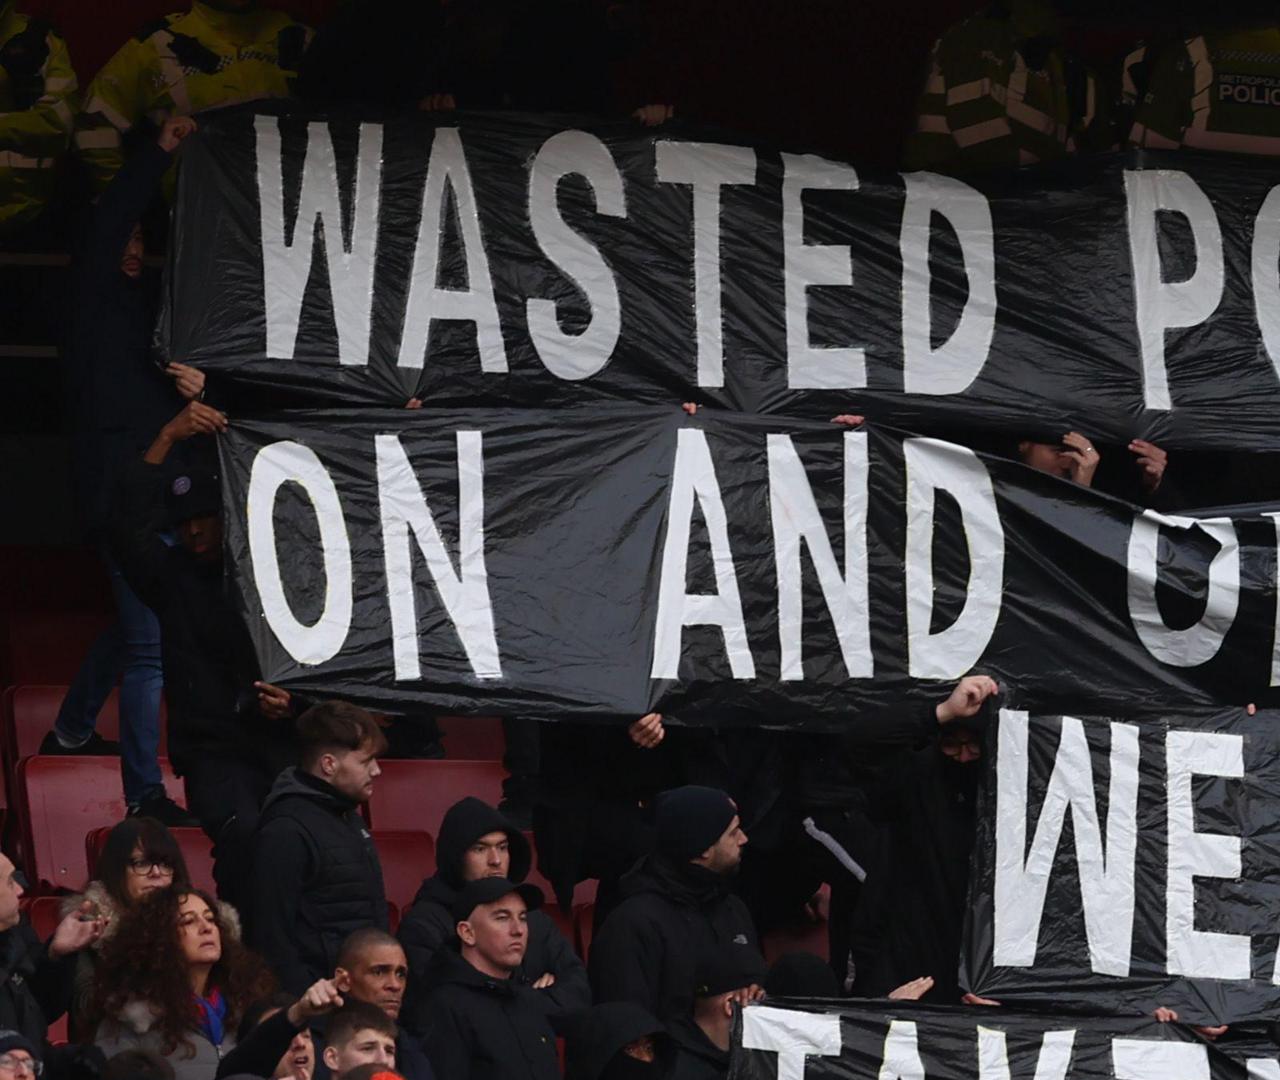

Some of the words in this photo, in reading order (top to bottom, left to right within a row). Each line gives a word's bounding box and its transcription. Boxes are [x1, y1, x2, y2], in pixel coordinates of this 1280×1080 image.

[252, 114, 998, 397] WASTED
[246, 430, 505, 683] ON
[651, 427, 1005, 683] AND
